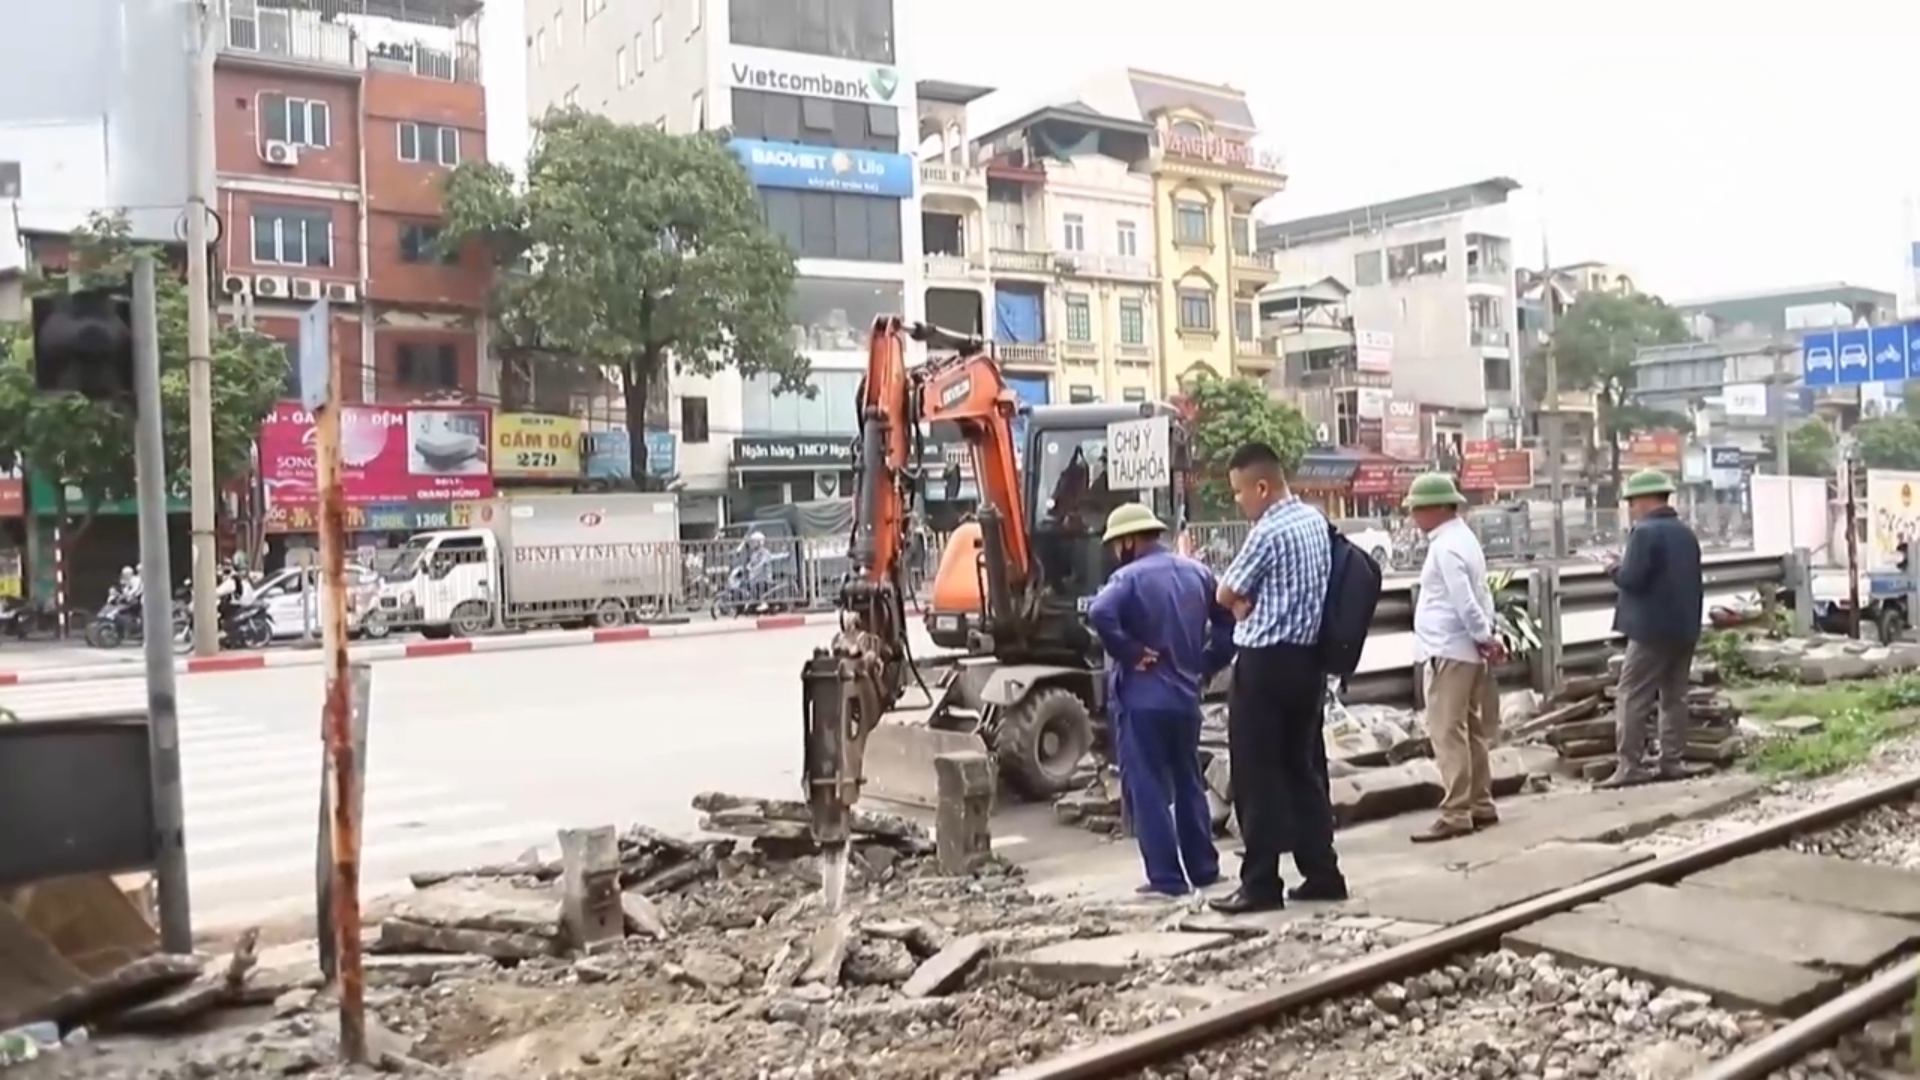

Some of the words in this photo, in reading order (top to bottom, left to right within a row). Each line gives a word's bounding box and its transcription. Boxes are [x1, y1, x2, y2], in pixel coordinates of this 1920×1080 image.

[731, 62, 870, 99] Vietcombank
[798, 443, 828, 458] TMCP
[517, 452, 557, 468] 279
[415, 513, 448, 528] 130K
